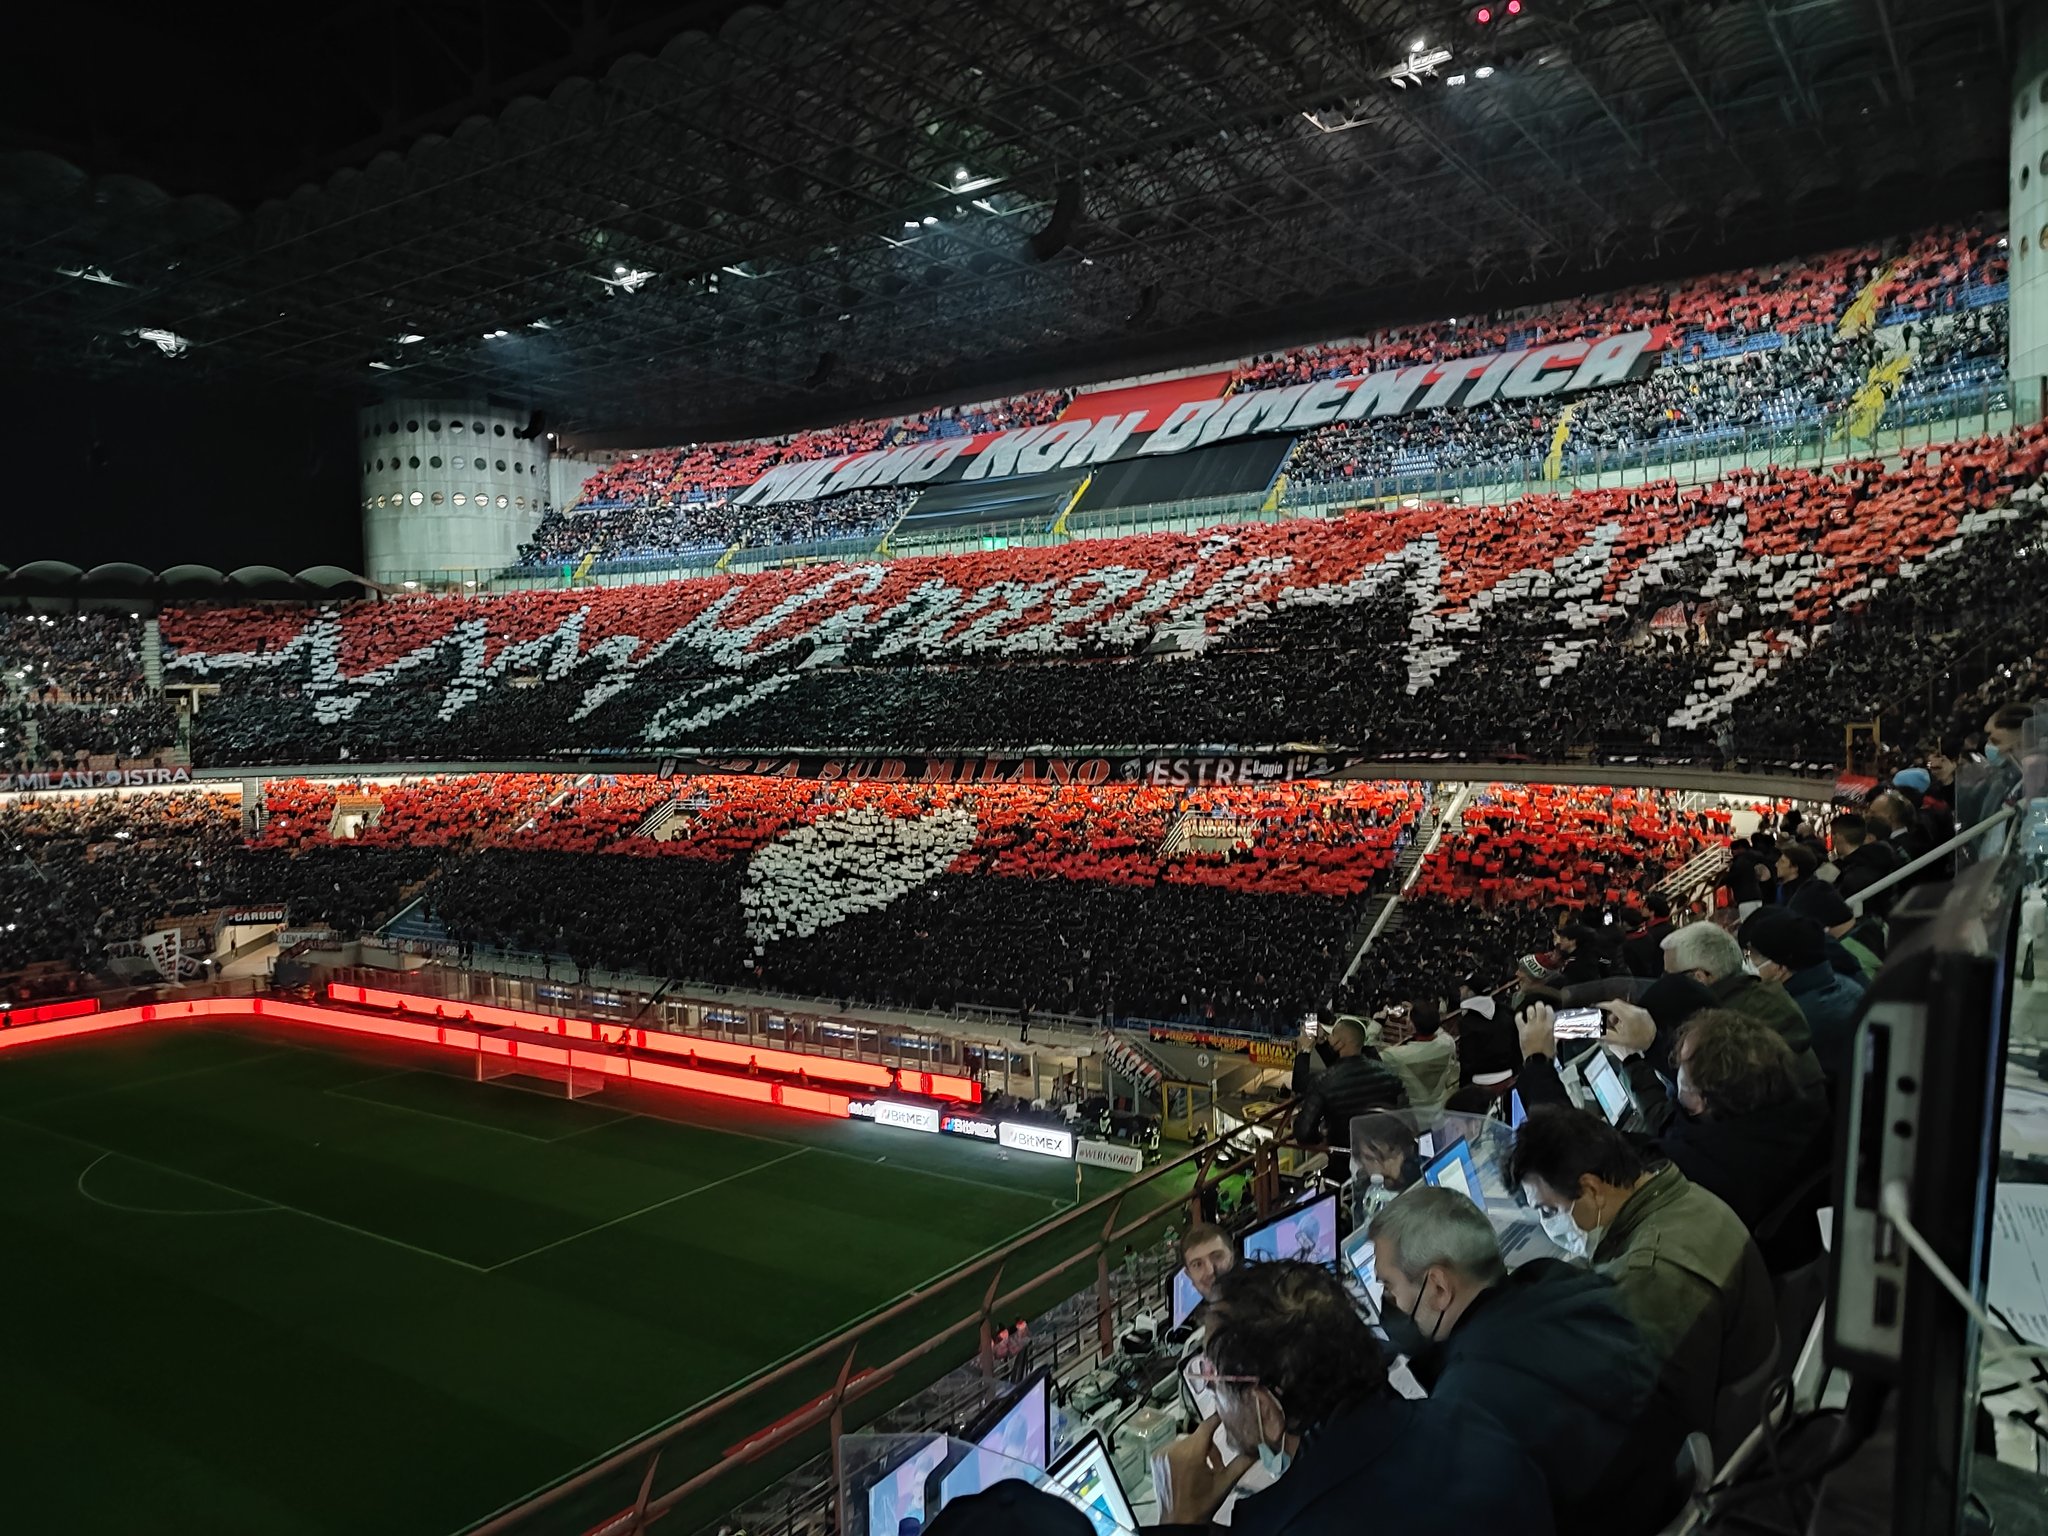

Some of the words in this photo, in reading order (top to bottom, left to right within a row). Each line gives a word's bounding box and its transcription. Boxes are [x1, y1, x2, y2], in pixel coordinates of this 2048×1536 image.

[733, 434, 975, 506] MILANO
[962, 409, 1149, 481] NON
[1136, 329, 1652, 455] DIMENTICA
[17, 772, 94, 790] MILAN
[124, 767, 191, 786] ISTRA
[817, 758, 907, 782] SUD
[920, 758, 1111, 785] MILANO
[1252, 759, 1283, 778] Baggio
[890, 1109, 931, 1126] BitMEX
[953, 1118, 997, 1139] BitMEX
[1018, 1133, 1063, 1152] BitMEX
